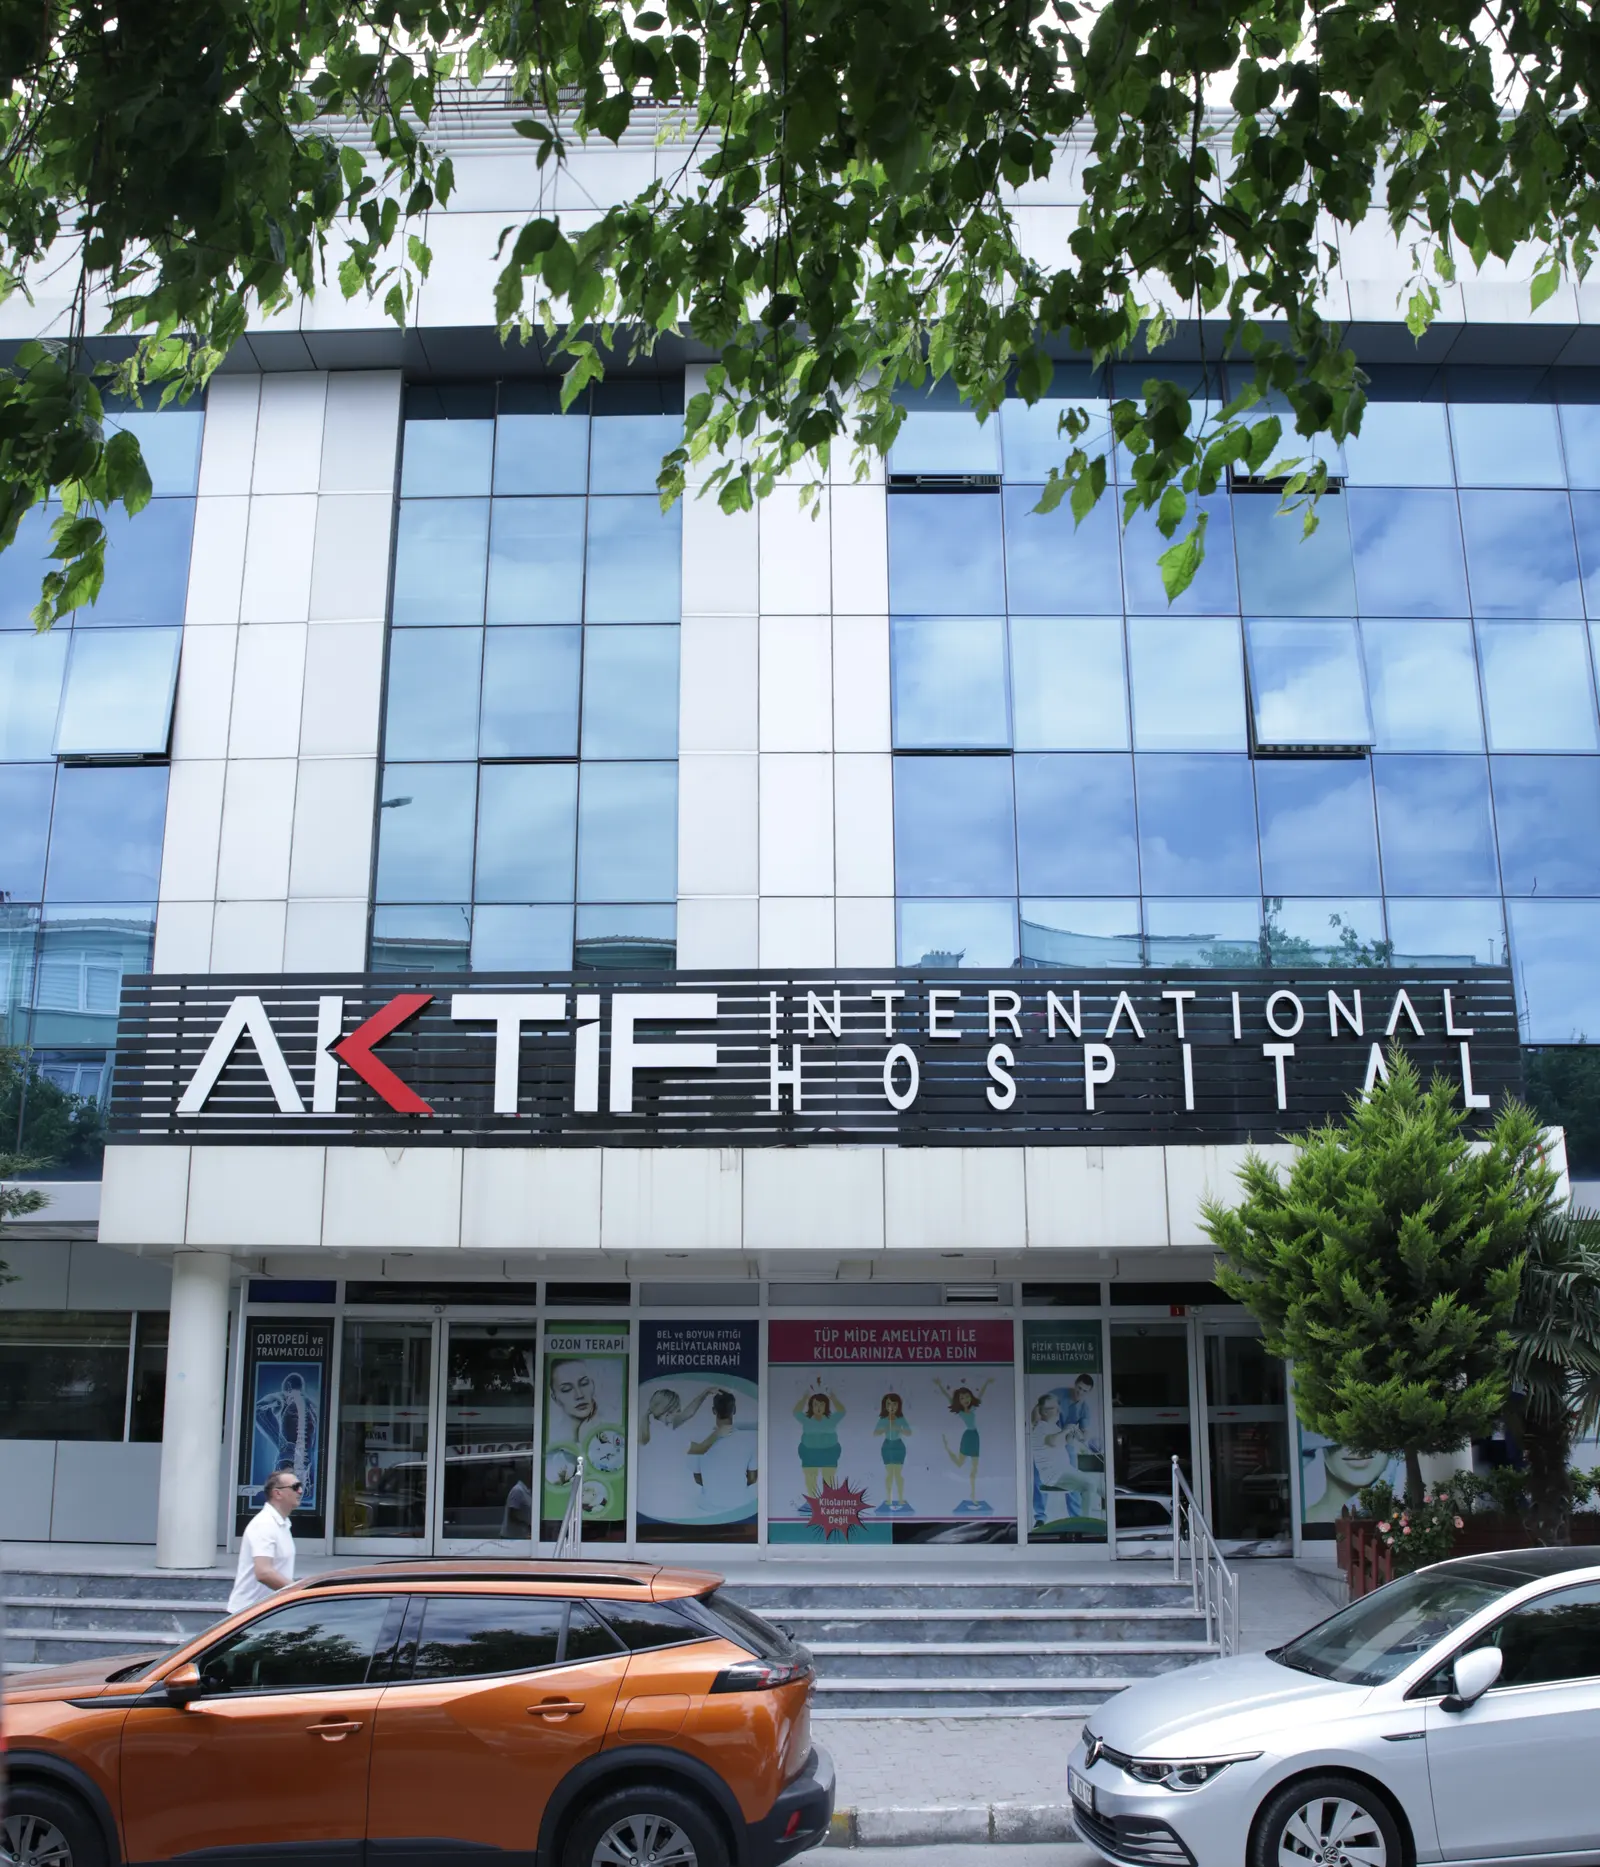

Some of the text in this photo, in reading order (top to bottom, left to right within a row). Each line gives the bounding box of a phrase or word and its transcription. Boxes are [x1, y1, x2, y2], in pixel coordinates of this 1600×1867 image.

[770, 988, 1473, 1039] INTERNATIONAL
[770, 1042, 1490, 1110] HOSPITAL
[257, 1332, 324, 1345] ORTOPEDİ ve
[657, 1330, 672, 1339] BEL
[686, 1330, 715, 1339] BOYUN
[814, 1327, 840, 1342] TÜP
[844, 1327, 877, 1342] MİDE
[956, 1327, 977, 1342] İLE
[550, 1336, 625, 1350] OZON TERAPİ
[656, 1340, 741, 1351] AMELİYATLARINDA
[256, 1346, 324, 1357] TRAVMATOLOJİ
[813, 1344, 903, 1359] KİLOLARINIZA
[907, 1347, 942, 1359] VEDA
